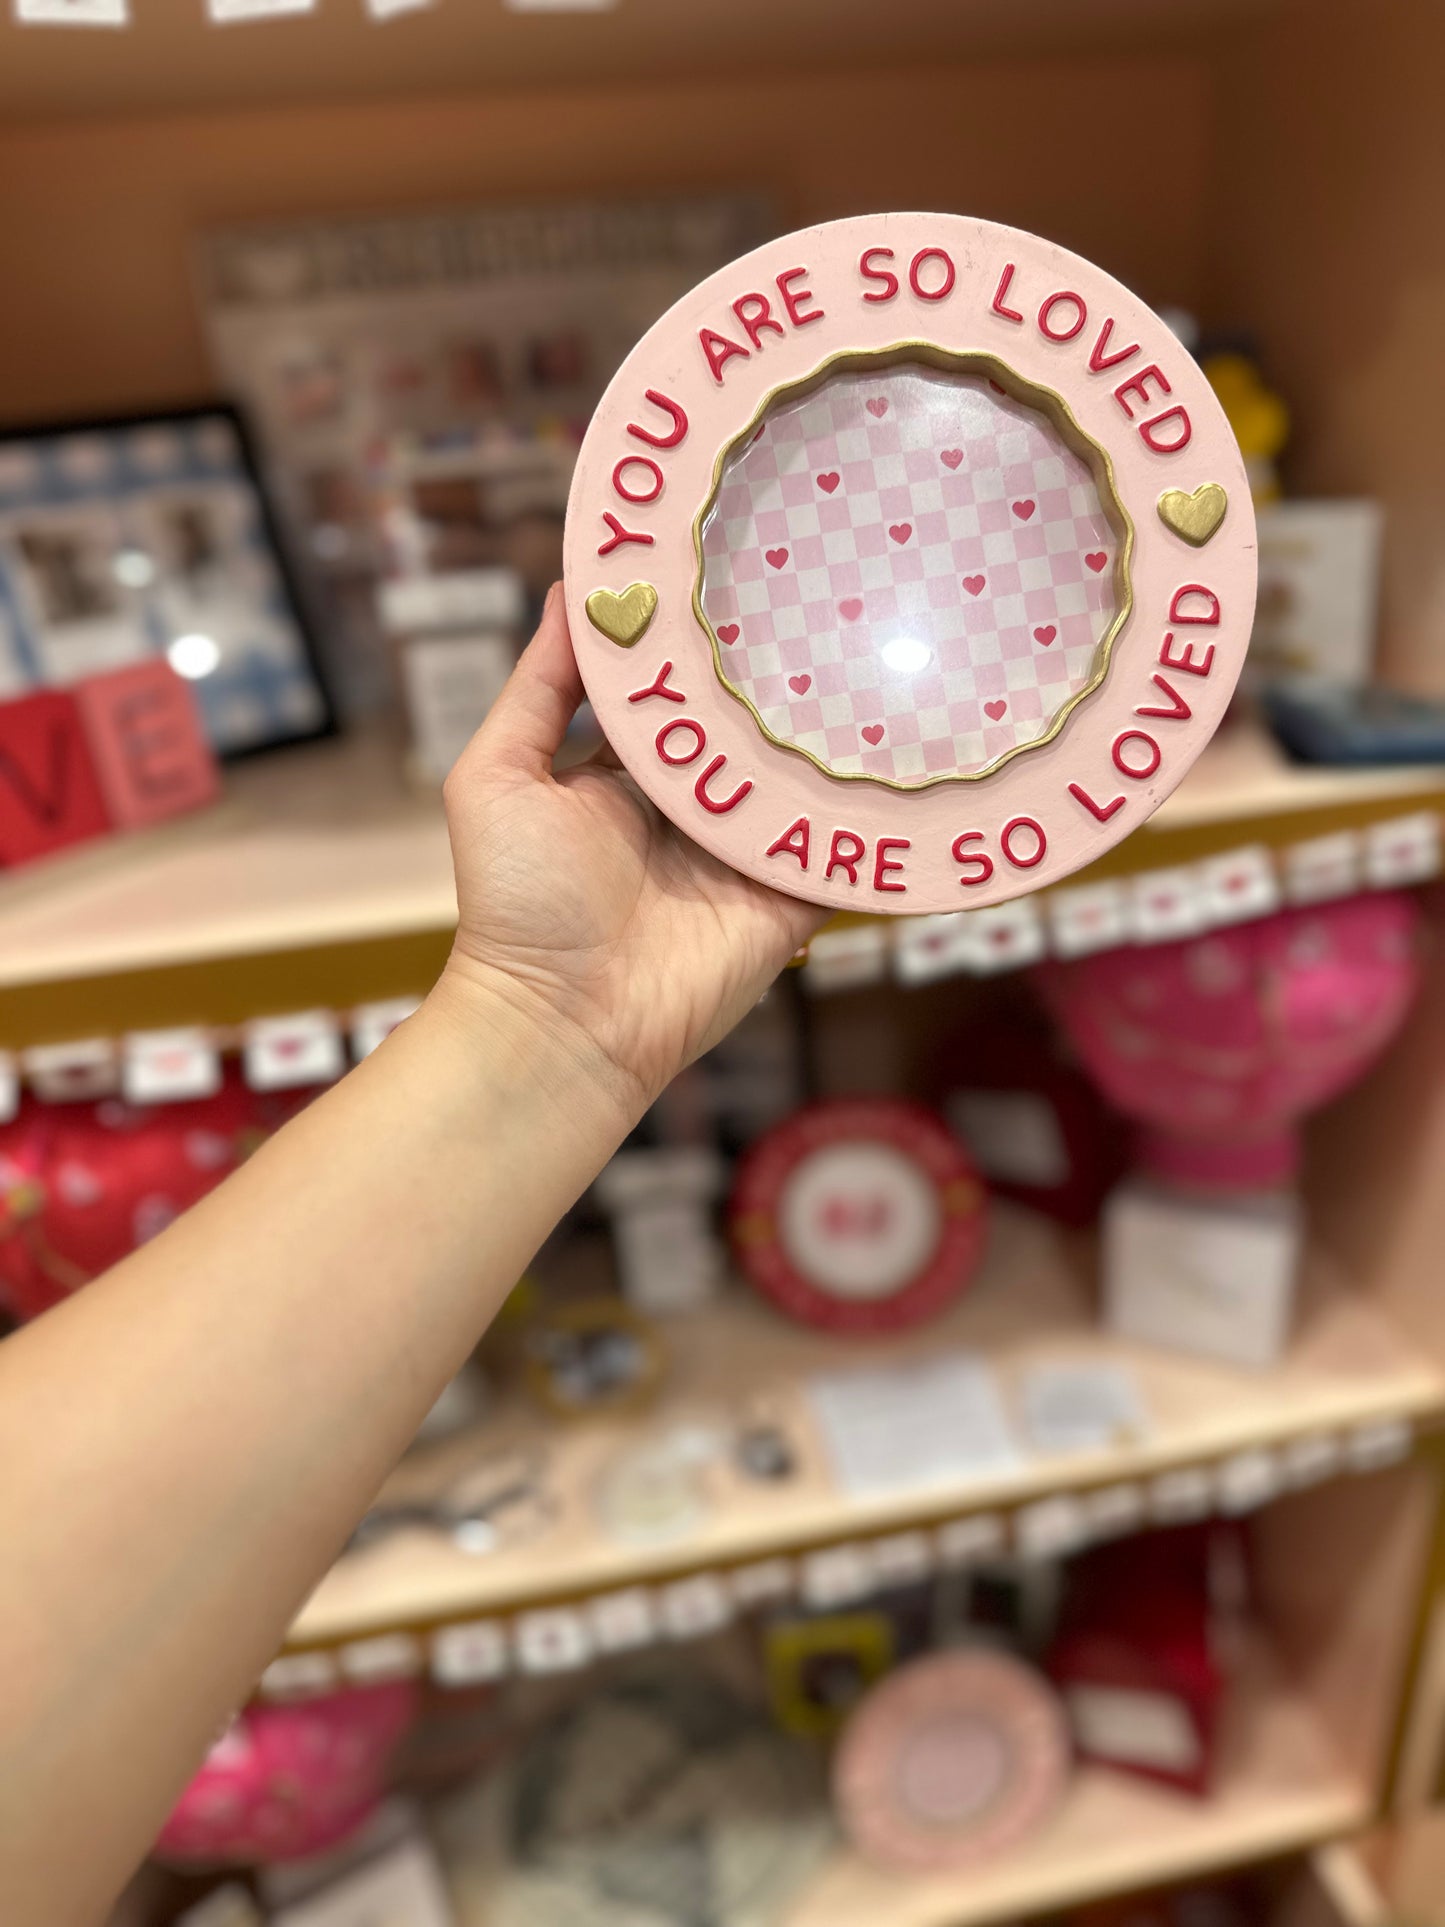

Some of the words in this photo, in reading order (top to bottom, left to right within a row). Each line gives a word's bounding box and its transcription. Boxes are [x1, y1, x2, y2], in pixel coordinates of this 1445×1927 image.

[597, 389, 689, 557] YOU
[698, 267, 825, 382] ARE
[859, 247, 956, 303] SO
[992, 263, 1192, 454] LOVED
[627, 661, 753, 815] YOU
[765, 817, 911, 893] ARE
[951, 816, 1047, 887] SO
[1067, 583, 1221, 823] LOVED
